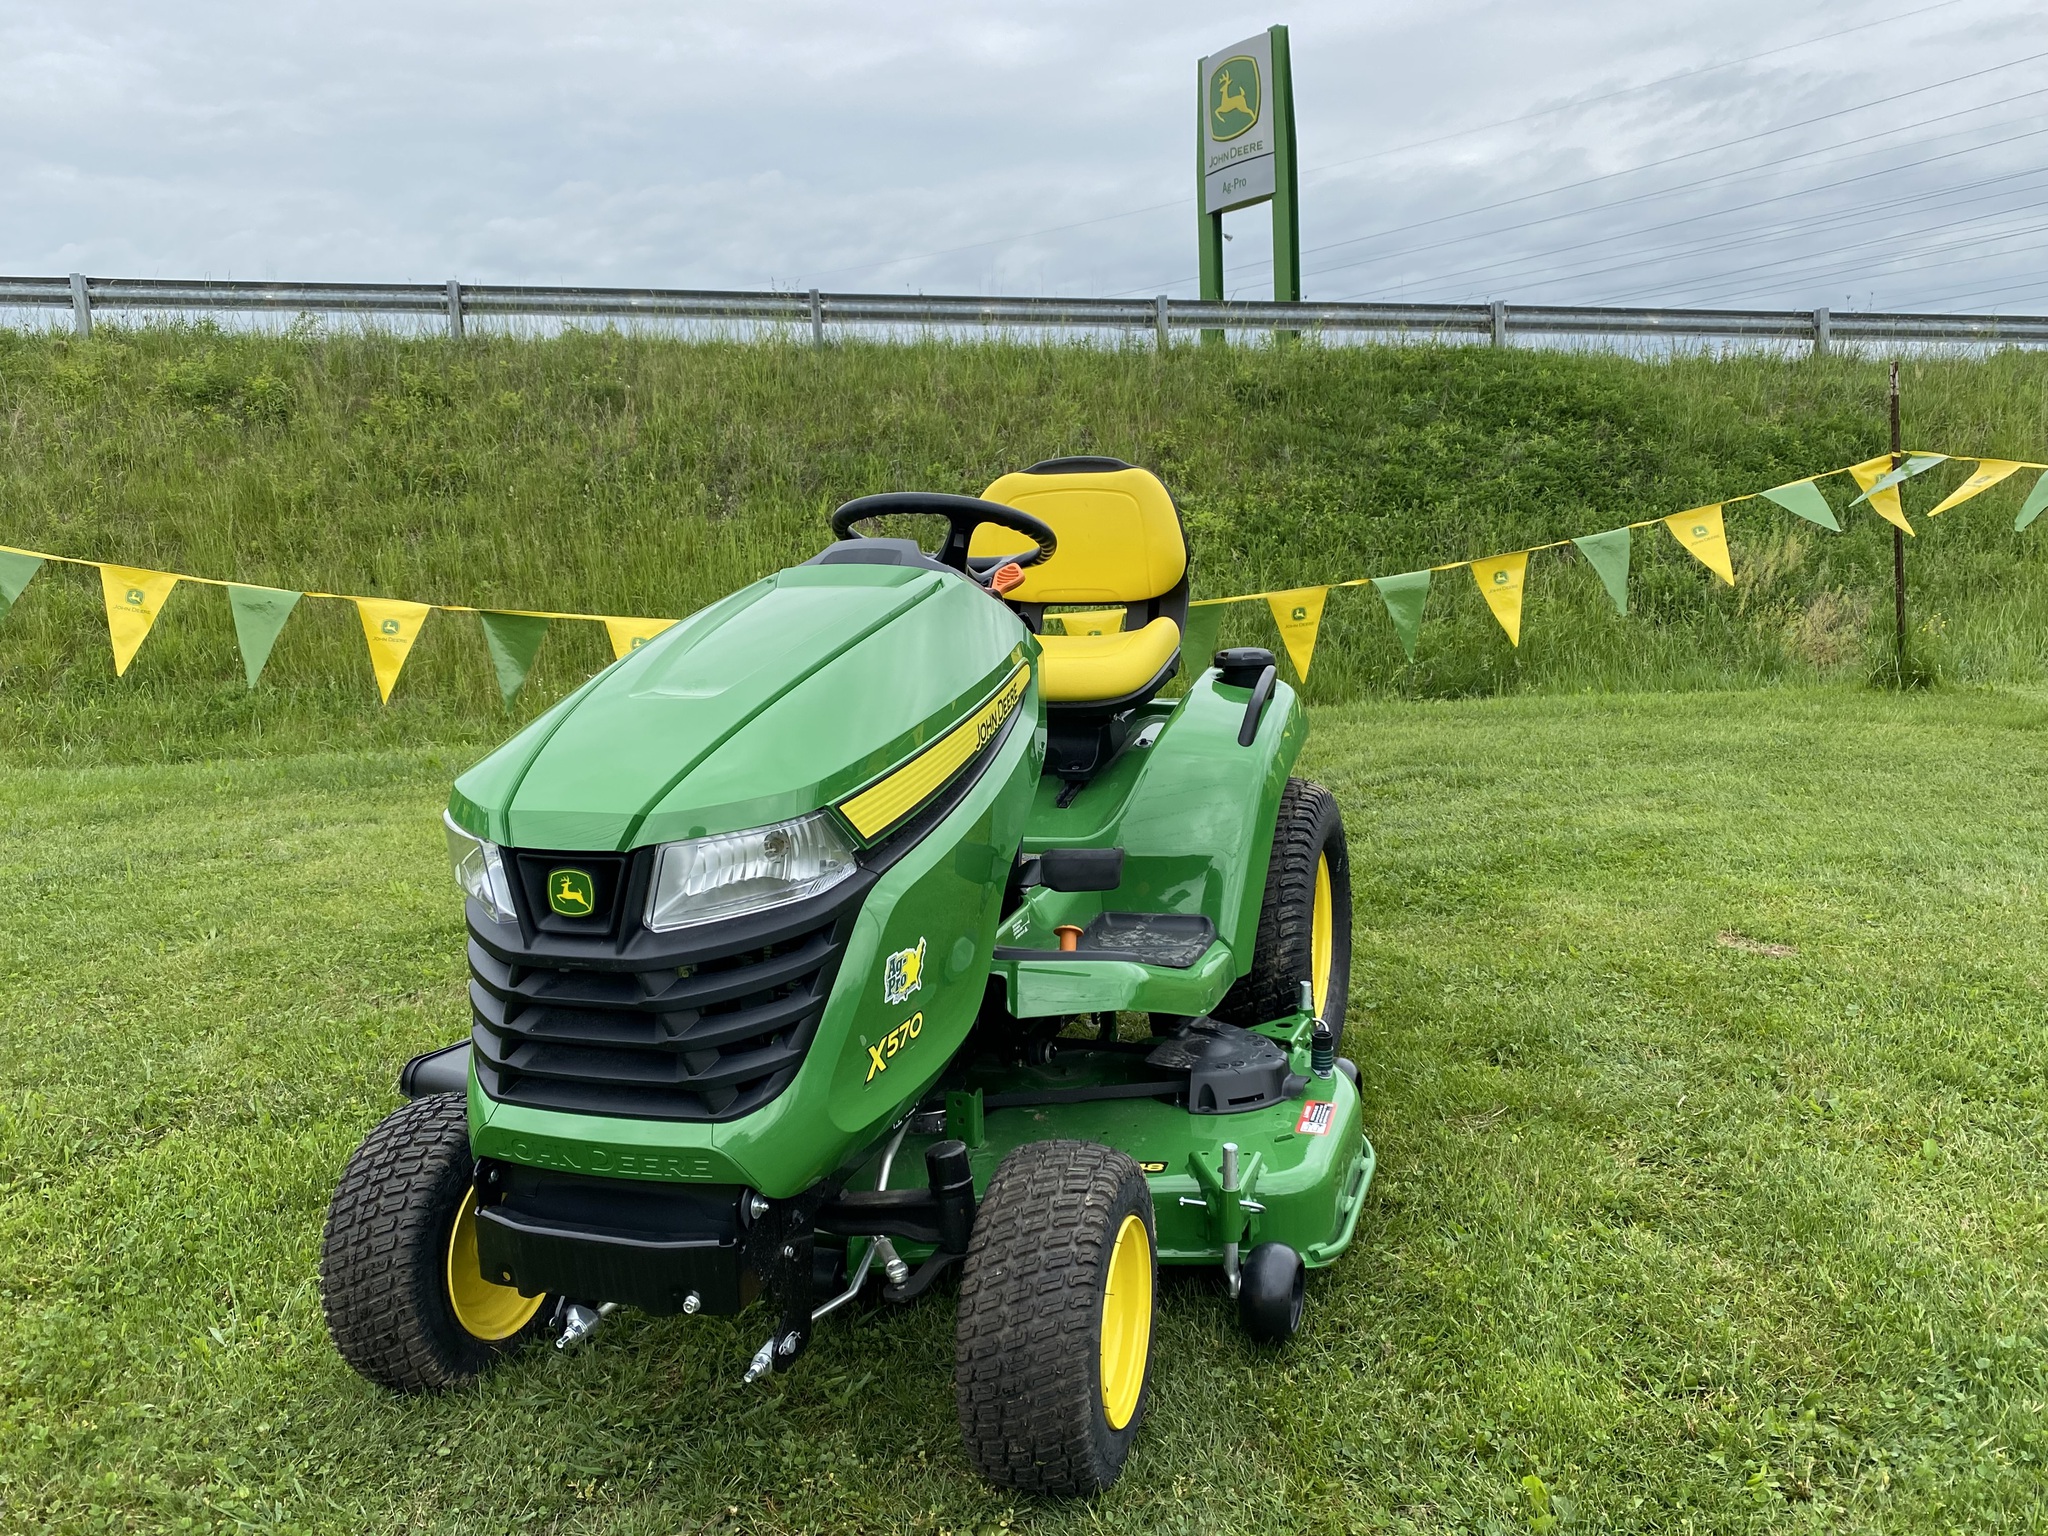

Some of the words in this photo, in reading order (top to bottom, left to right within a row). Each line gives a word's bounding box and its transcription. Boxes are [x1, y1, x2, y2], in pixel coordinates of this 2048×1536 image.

[1209, 152, 1230, 168] JOHN
[1230, 140, 1263, 159] DEERE
[1222, 178, 1247, 195] Ag-Pro
[976, 710, 998, 751] JOHN
[997, 682, 1018, 723] DEERE
[887, 973, 907, 998] Pro
[865, 1010, 924, 1085] X570
[496, 1132, 582, 1169] JOHN
[585, 1144, 713, 1179] DEERE
